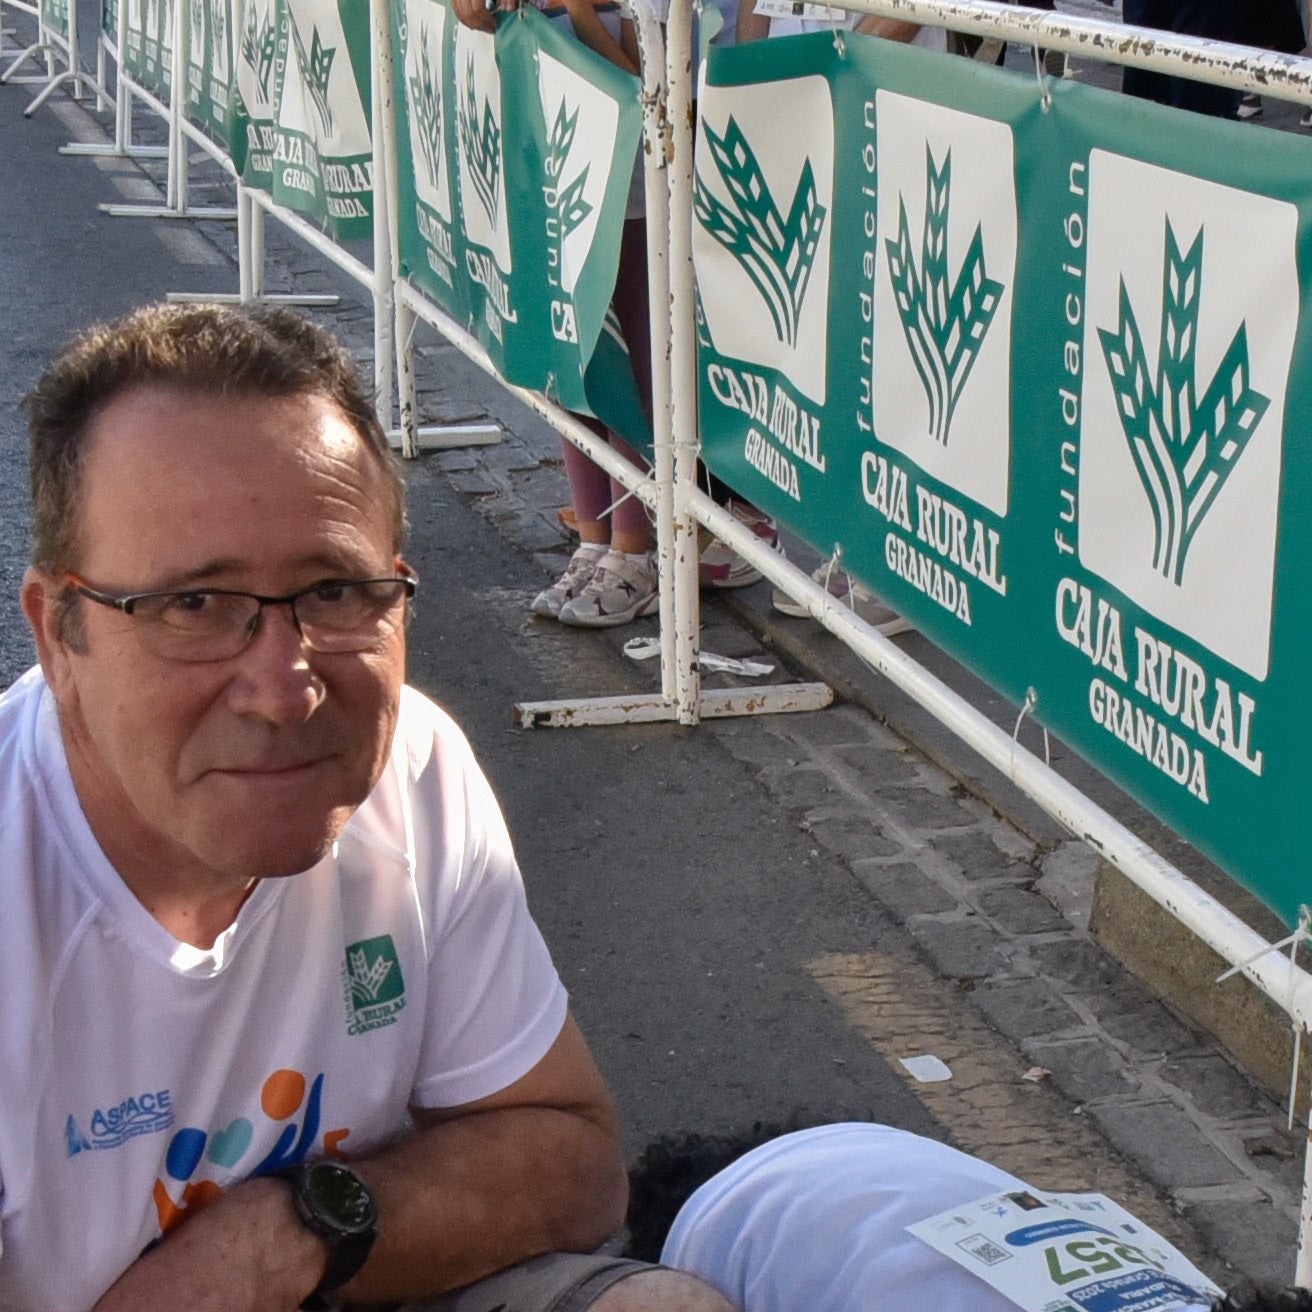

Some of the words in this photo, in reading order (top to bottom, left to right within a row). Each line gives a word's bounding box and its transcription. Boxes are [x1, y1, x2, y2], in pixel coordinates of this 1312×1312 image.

[856, 100, 876, 433] fundación
[707, 363, 768, 426] CAJA
[769, 385, 826, 474] RURAL
[1054, 160, 1086, 556] fundación
[744, 428, 801, 502] GRANADA
[861, 451, 912, 533] CAJA
[916, 484, 1007, 597] RURAL
[885, 532, 972, 627] GRANADA
[1055, 577, 1128, 683] CAJA
[1134, 626, 1263, 778] RURAL
[1089, 678, 1209, 805] GRANADA
